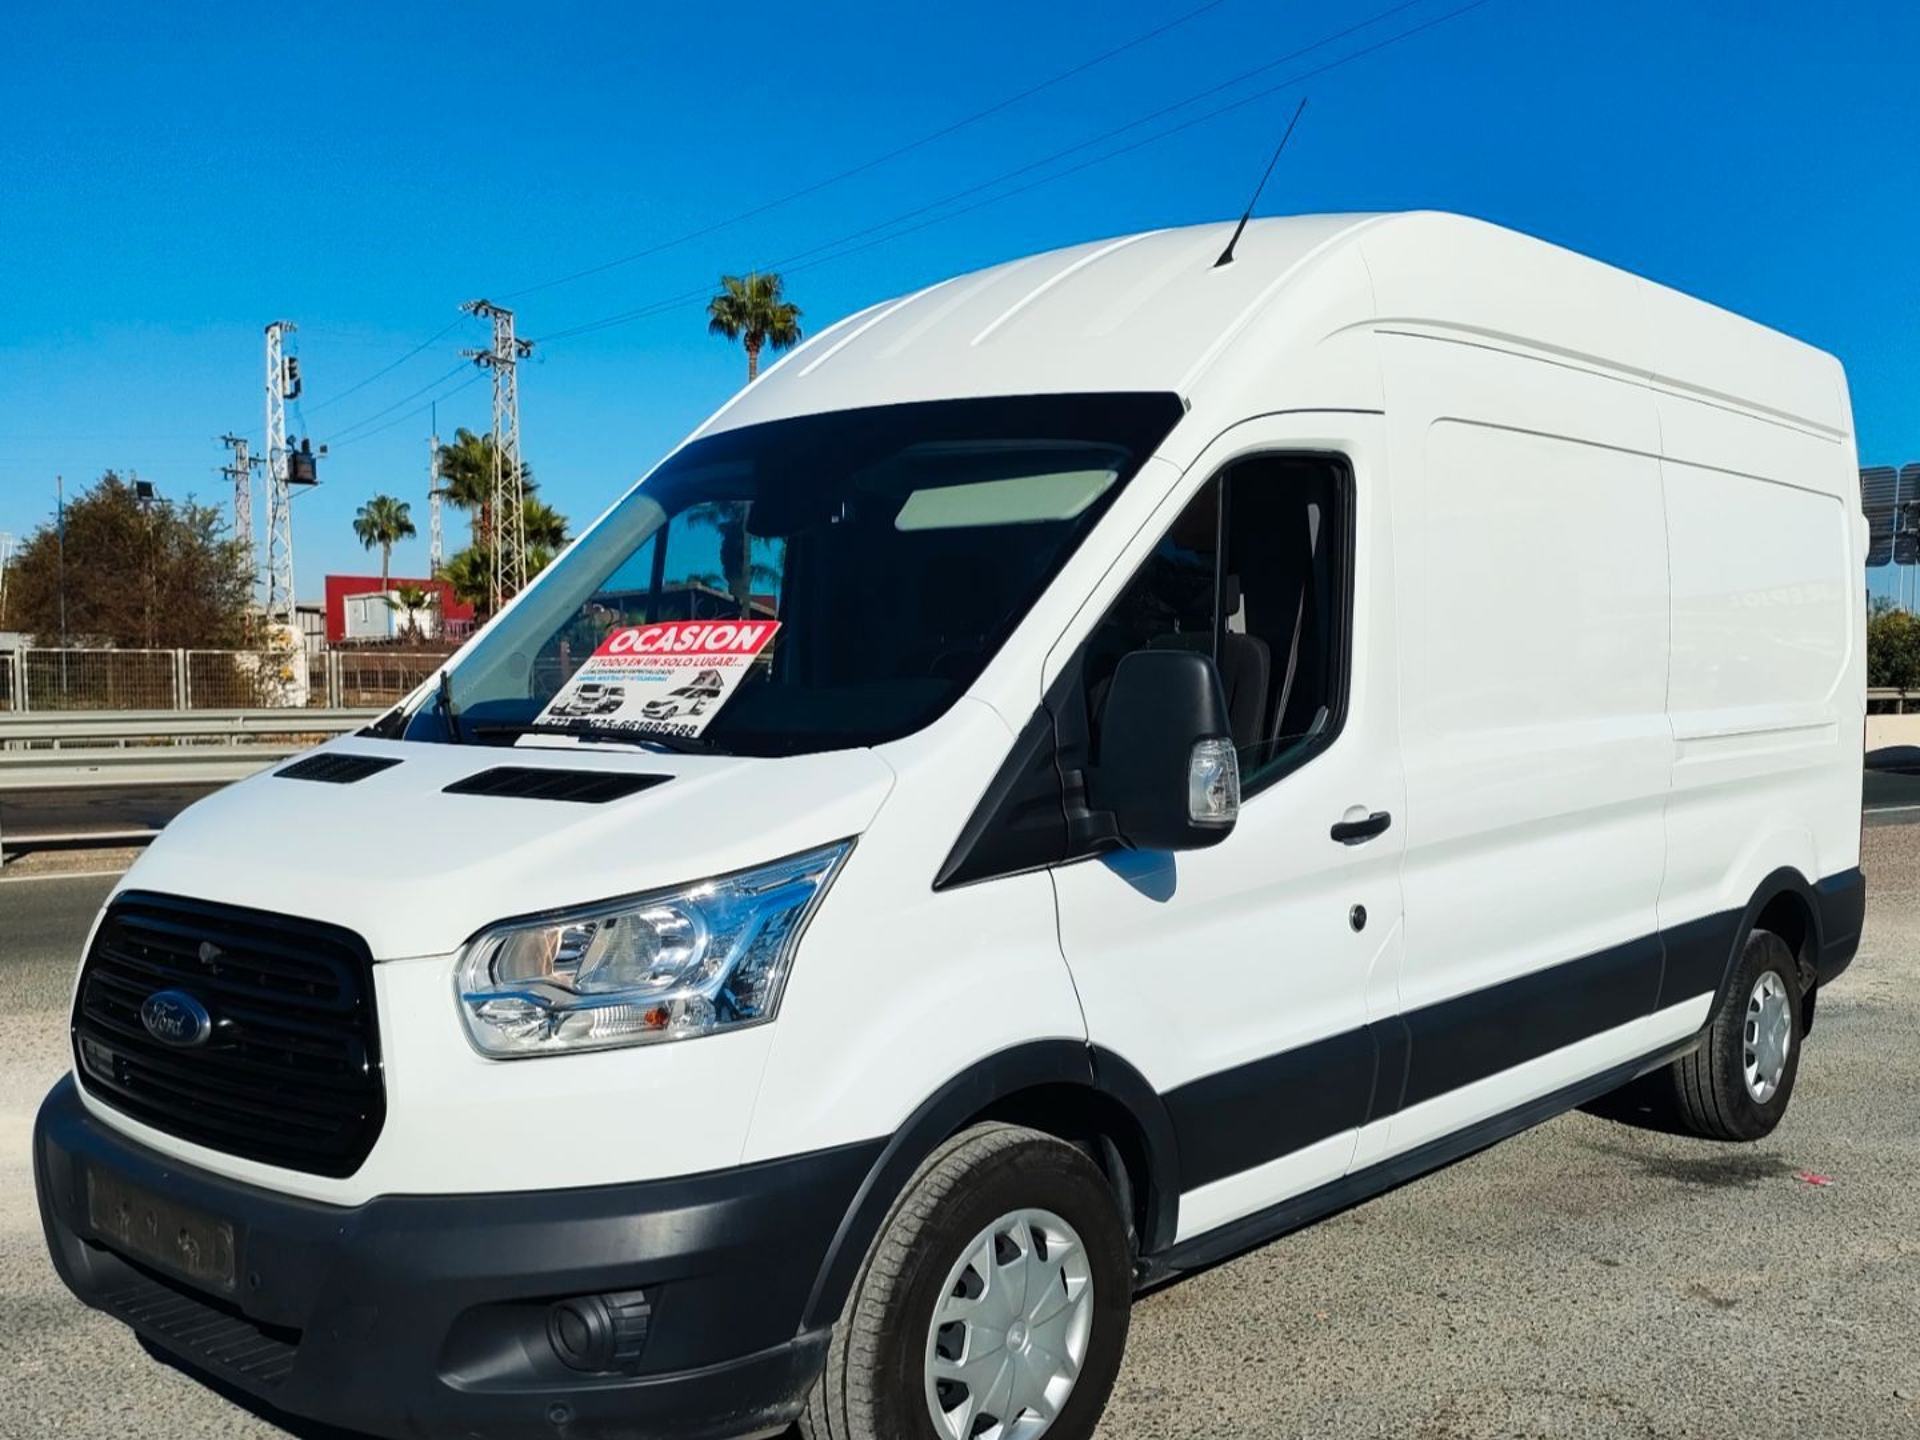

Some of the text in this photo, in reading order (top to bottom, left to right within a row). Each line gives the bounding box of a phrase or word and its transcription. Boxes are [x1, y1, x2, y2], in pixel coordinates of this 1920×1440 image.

[609, 625, 765, 653] OCASION
[626, 657, 641, 668] EN
[643, 657, 660, 668] UN
[659, 657, 694, 668] SOLO
[148, 1001, 186, 1036] Ford
